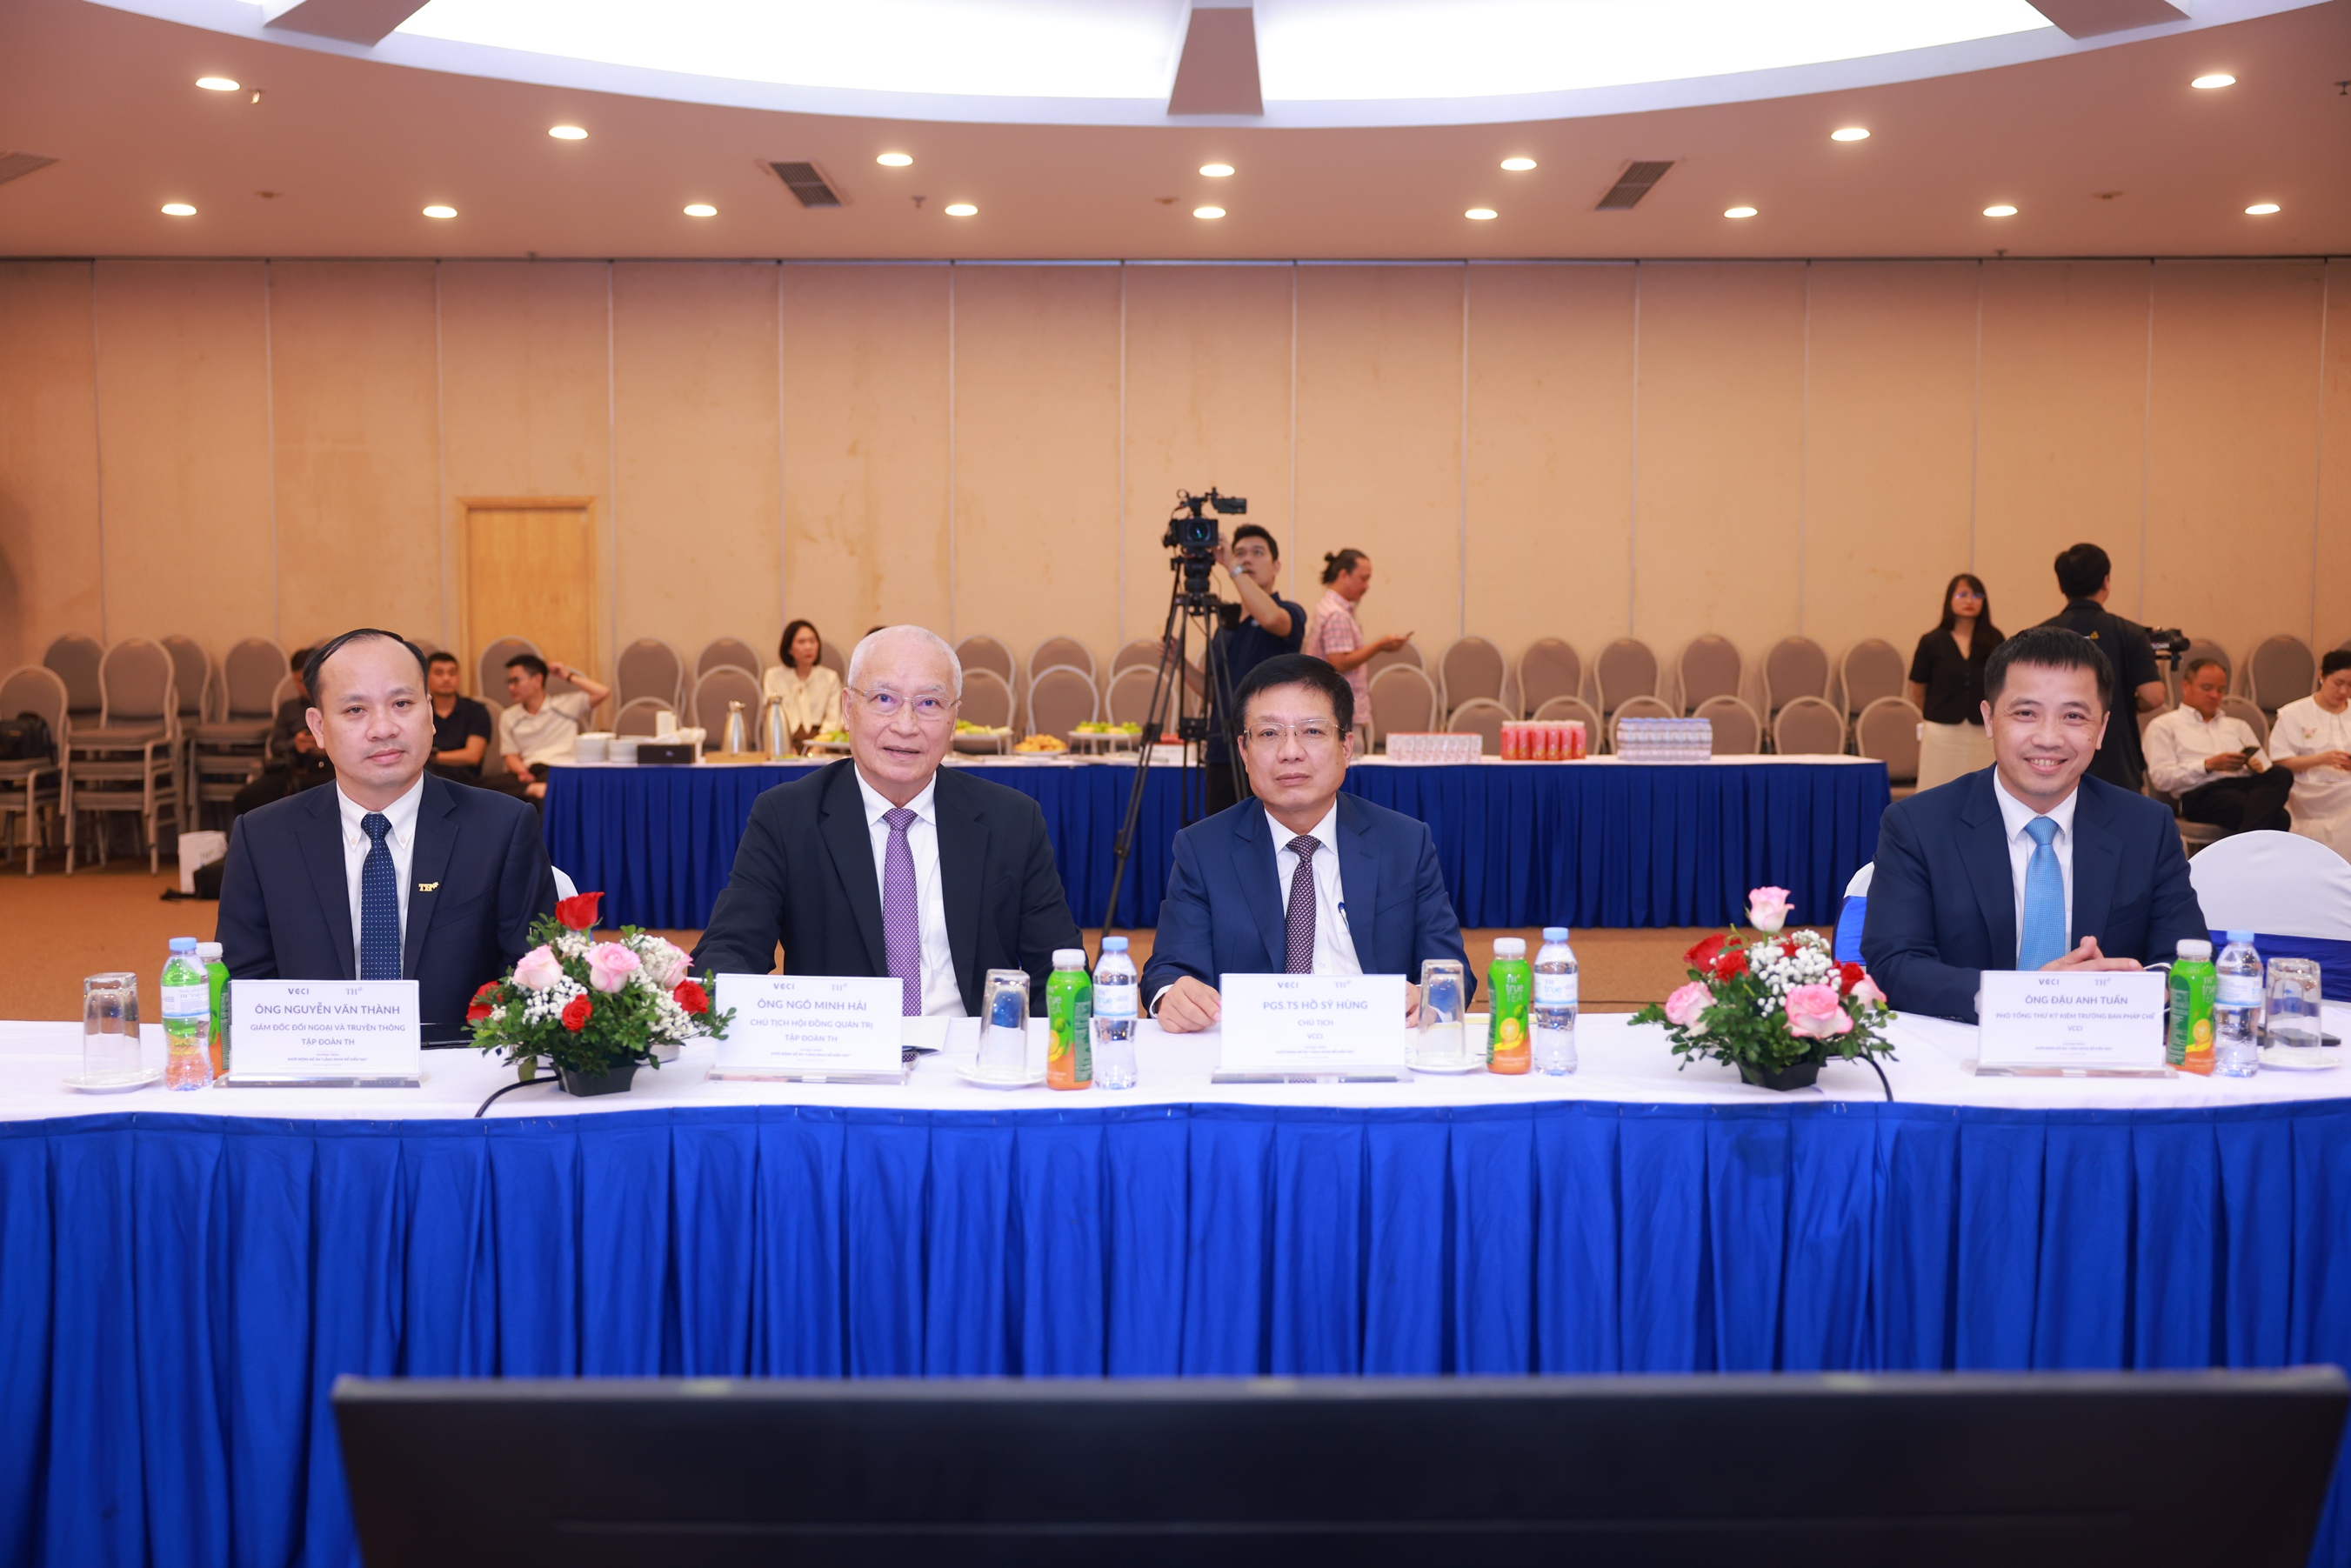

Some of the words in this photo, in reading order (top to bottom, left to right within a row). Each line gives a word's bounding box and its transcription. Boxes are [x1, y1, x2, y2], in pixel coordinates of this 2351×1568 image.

[1506, 984, 1524, 993] true
[1544, 984, 1562, 993] true
[1506, 992, 1523, 1002] TEA
[2026, 994, 2048, 1004] ÔNG
[2051, 995, 2073, 1006] ĐẬU
[2101, 994, 2127, 1004] TUẤN
[255, 1004, 281, 1014] ÔNG
[284, 1001, 331, 1014] NGUYỄN
[334, 1004, 357, 1014] VĂN
[361, 1004, 400, 1014] THÀNH
[758, 998, 783, 1009] ÔNG
[787, 999, 811, 1009] NGÔ
[815, 1000, 845, 1011] MINH
[848, 1000, 867, 1011] HẢI
[1263, 1001, 1299, 1010] PGS.TS
[1302, 998, 1319, 1010] HỒ
[1321, 1000, 1333, 1010] SỸ
[250, 1023, 270, 1031] GIÁM
[273, 1023, 291, 1031] ĐỐC
[292, 1023, 306, 1031] ĐỐI
[308, 1024, 332, 1033] NGOẠI
[335, 1023, 344, 1031] VÀ
[347, 1022, 377, 1031] TRUYỀN
[771, 1019, 789, 1028] TỊCH
[791, 1019, 807, 1029] HỘI
[809, 1017, 832, 1028] ĐỒNG
[861, 1021, 873, 1031] TRỊ
[302, 1038, 317, 1047] TẬP
[785, 1033, 799, 1043] TẬP
[802, 1033, 825, 1042] ĐOÀN
